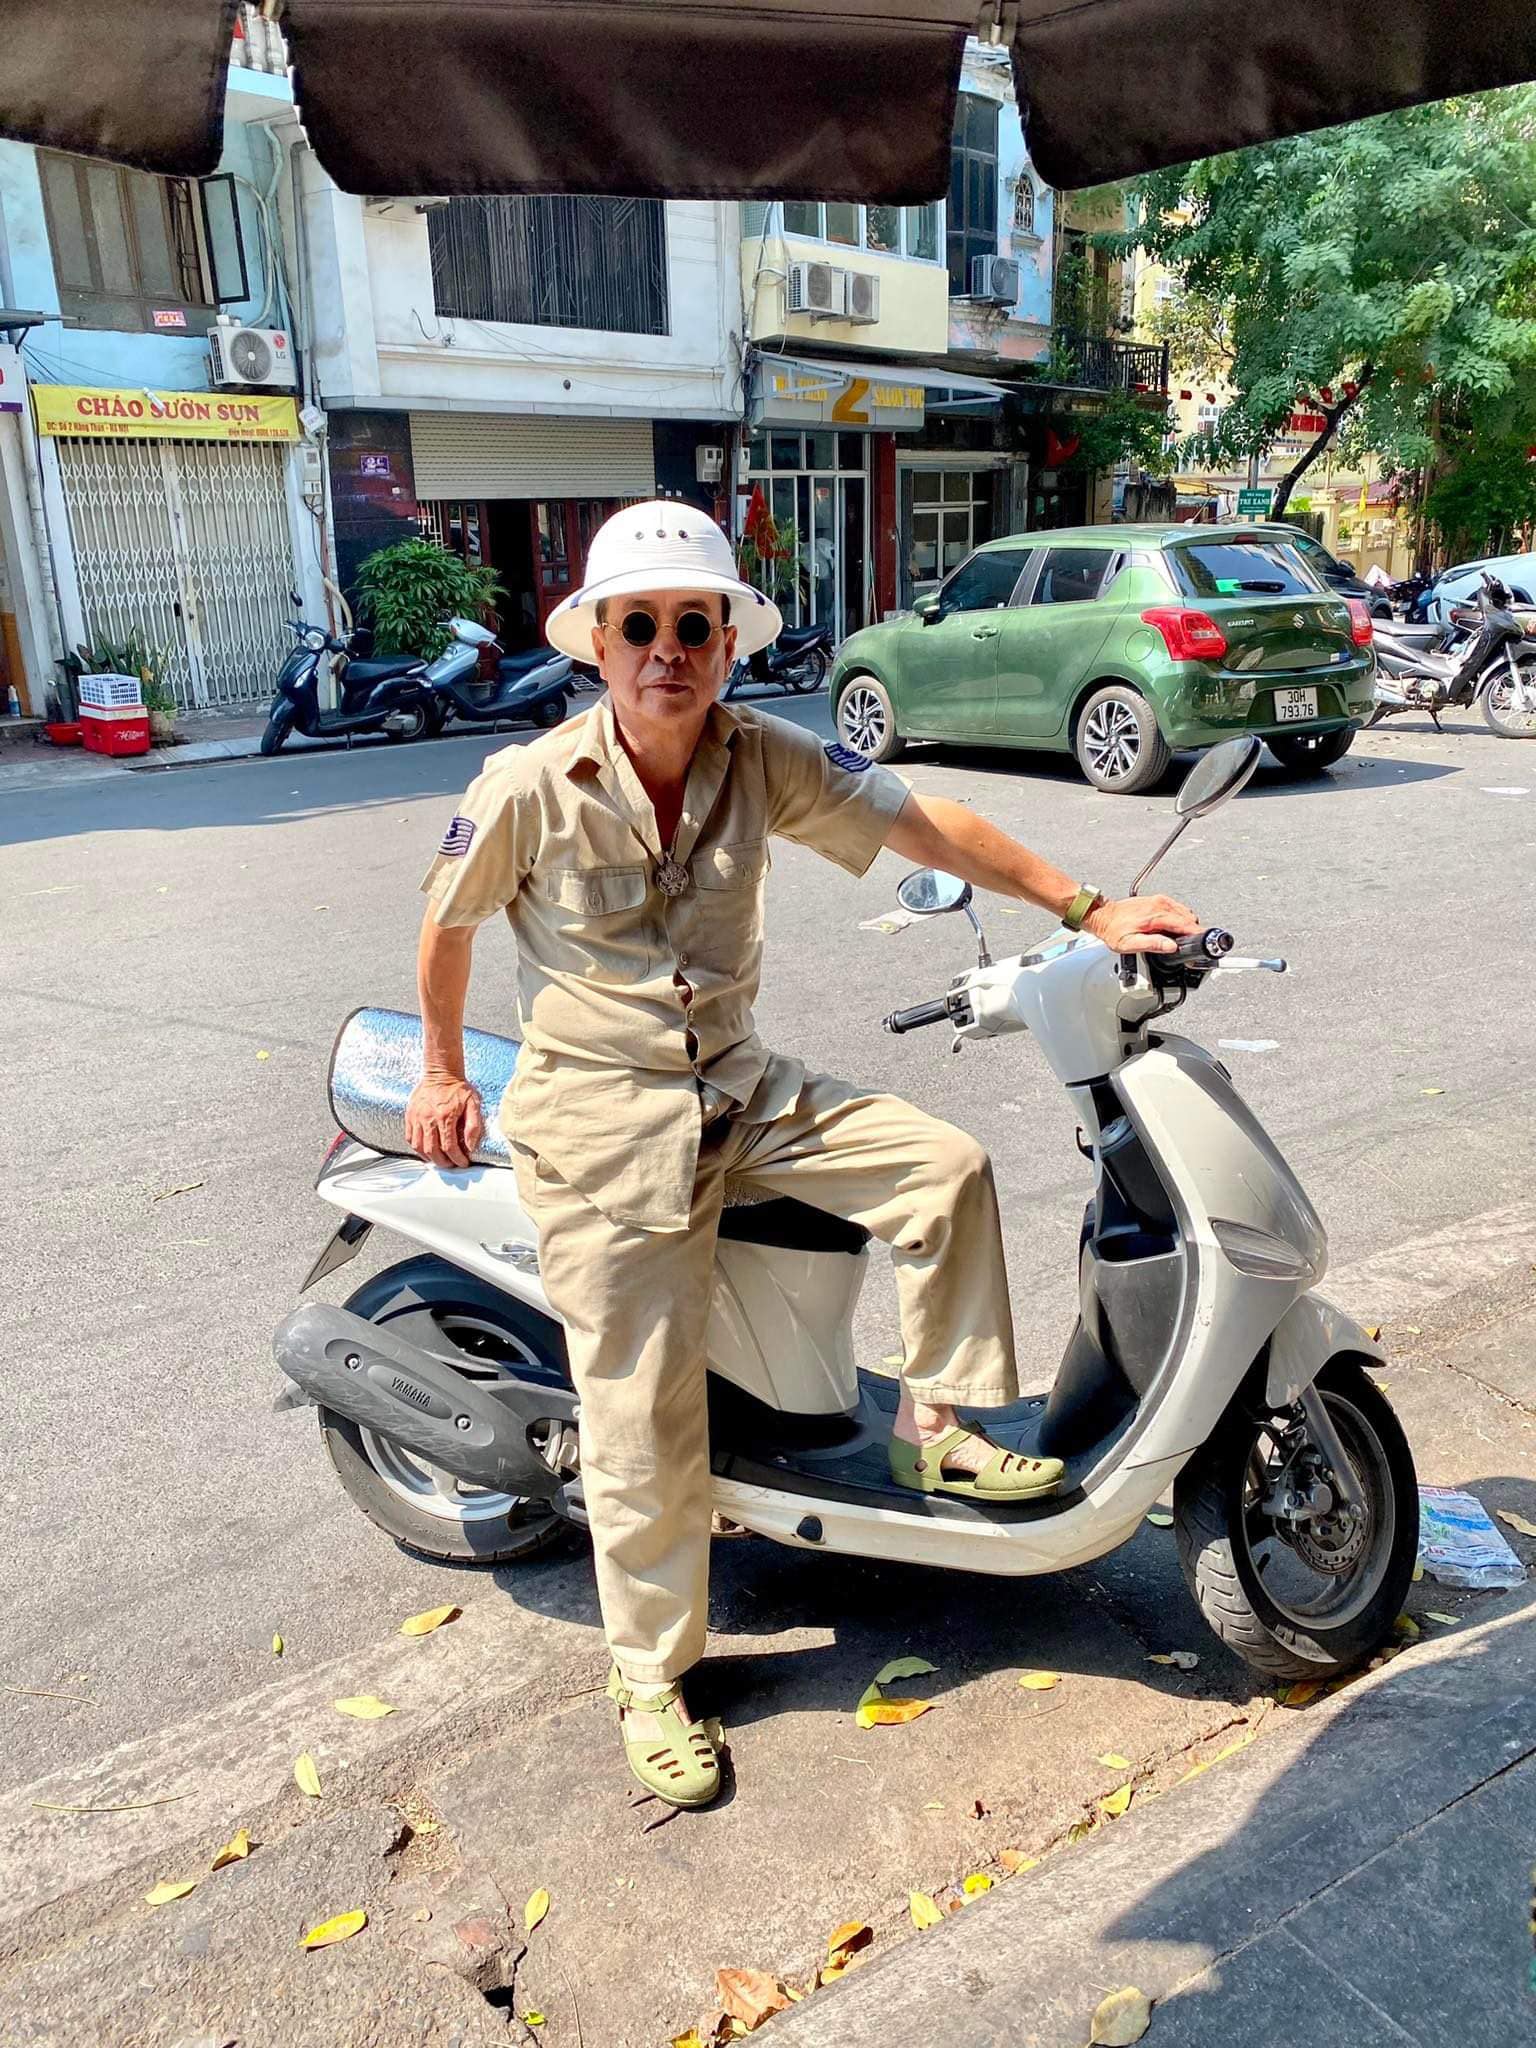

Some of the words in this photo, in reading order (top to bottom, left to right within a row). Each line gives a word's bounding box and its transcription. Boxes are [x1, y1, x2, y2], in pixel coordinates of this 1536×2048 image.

[276, 351, 286, 359] LG
[76, 394, 144, 418] CHÁO
[150, 397, 211, 420] SƯỜN
[216, 403, 260, 426] SỤN
[832, 377, 870, 423] 2
[1287, 690, 1306, 704] 30H
[391, 1376, 432, 1407] YAMAHA
